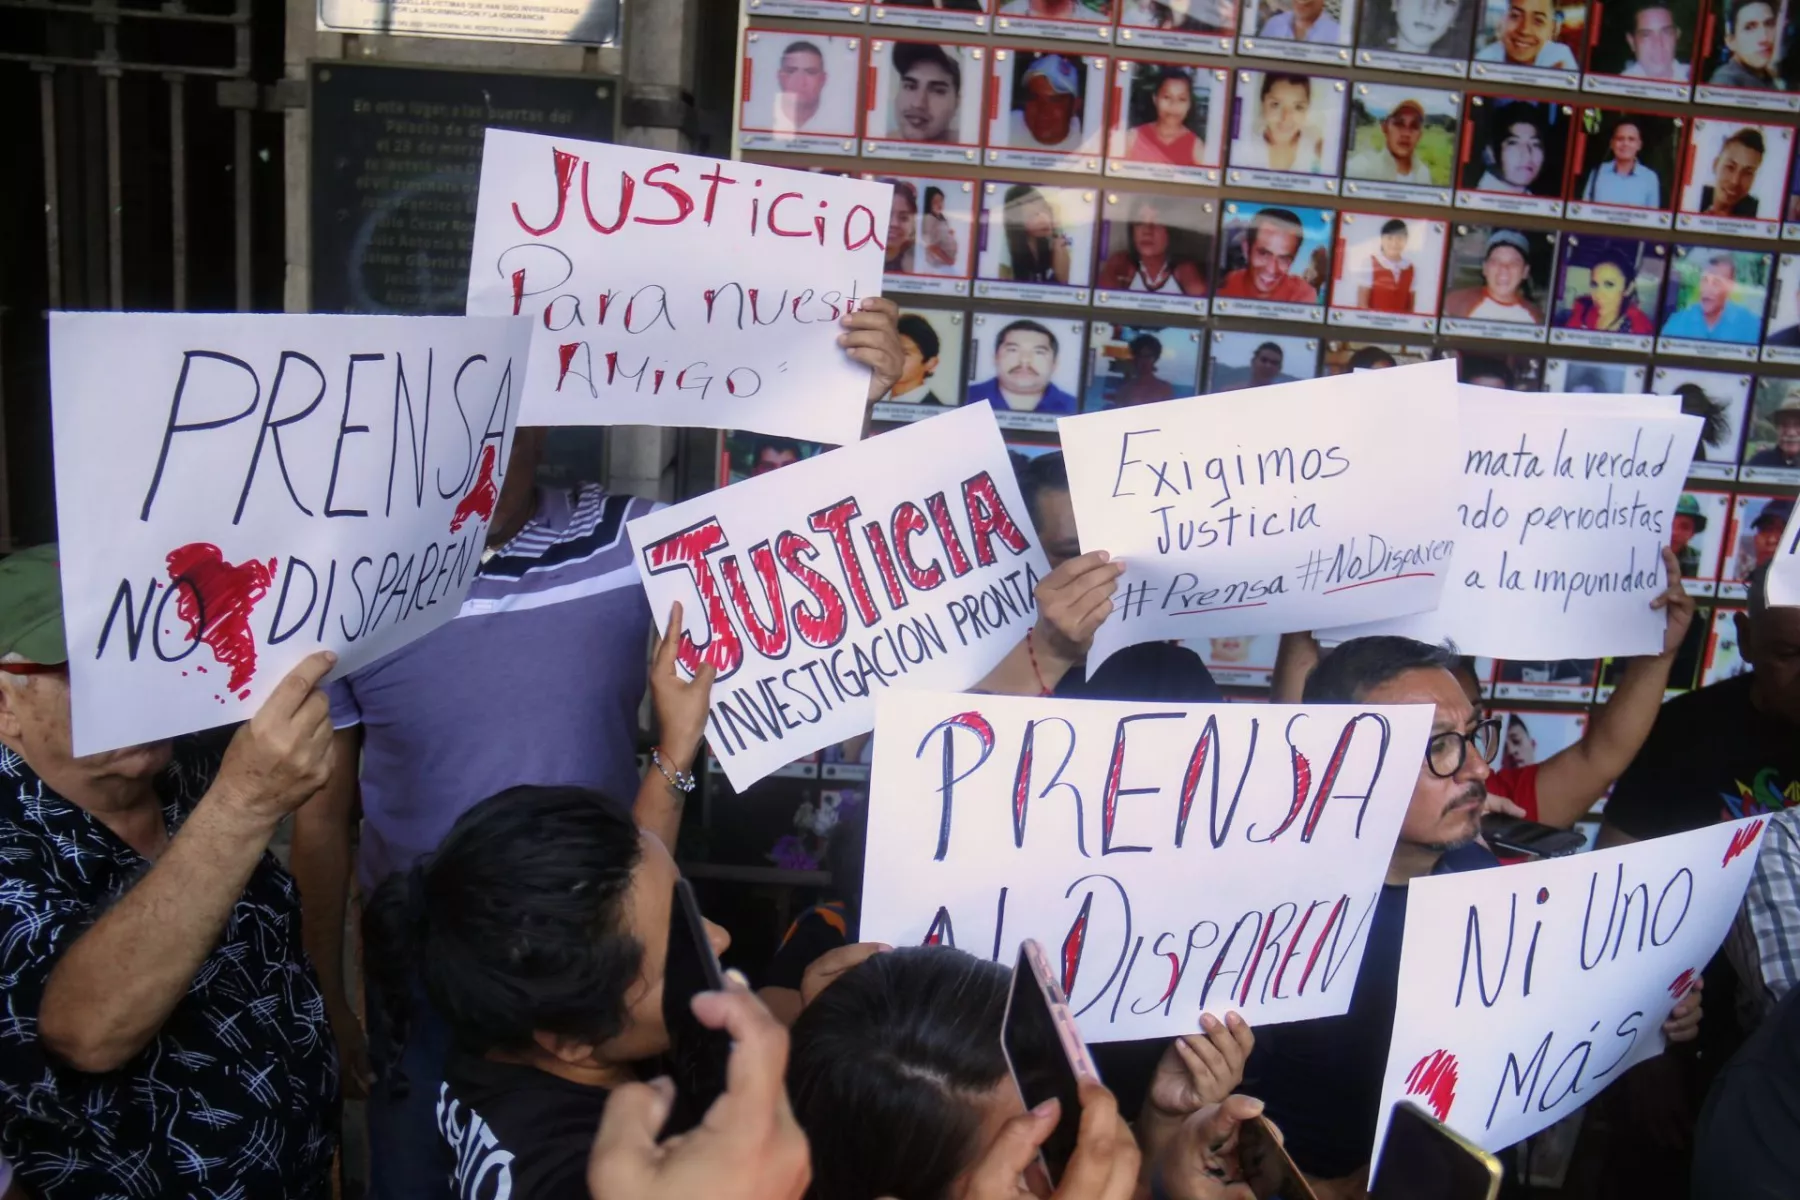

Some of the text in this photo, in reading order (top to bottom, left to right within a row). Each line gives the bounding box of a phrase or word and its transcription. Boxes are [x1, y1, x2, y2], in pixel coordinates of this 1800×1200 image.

[704, 280, 862, 330] nuest
[140, 347, 513, 526] PRENSA
[1111, 428, 1351, 509] Exigimos
[1464, 426, 1675, 481] mata la verdad
[1150, 495, 1322, 556] Justicia
[1522, 482, 1664, 546] periodistas
[96, 526, 479, 662] NO DISPAREN
[1112, 571, 1289, 622] #Prensa
[1463, 540, 1663, 615] a la impunidad
[707, 561, 1041, 757] INVESTIGACION PRONTA
[915, 709, 1393, 862] PRENSA
[1455, 886, 1550, 1009] Ni
